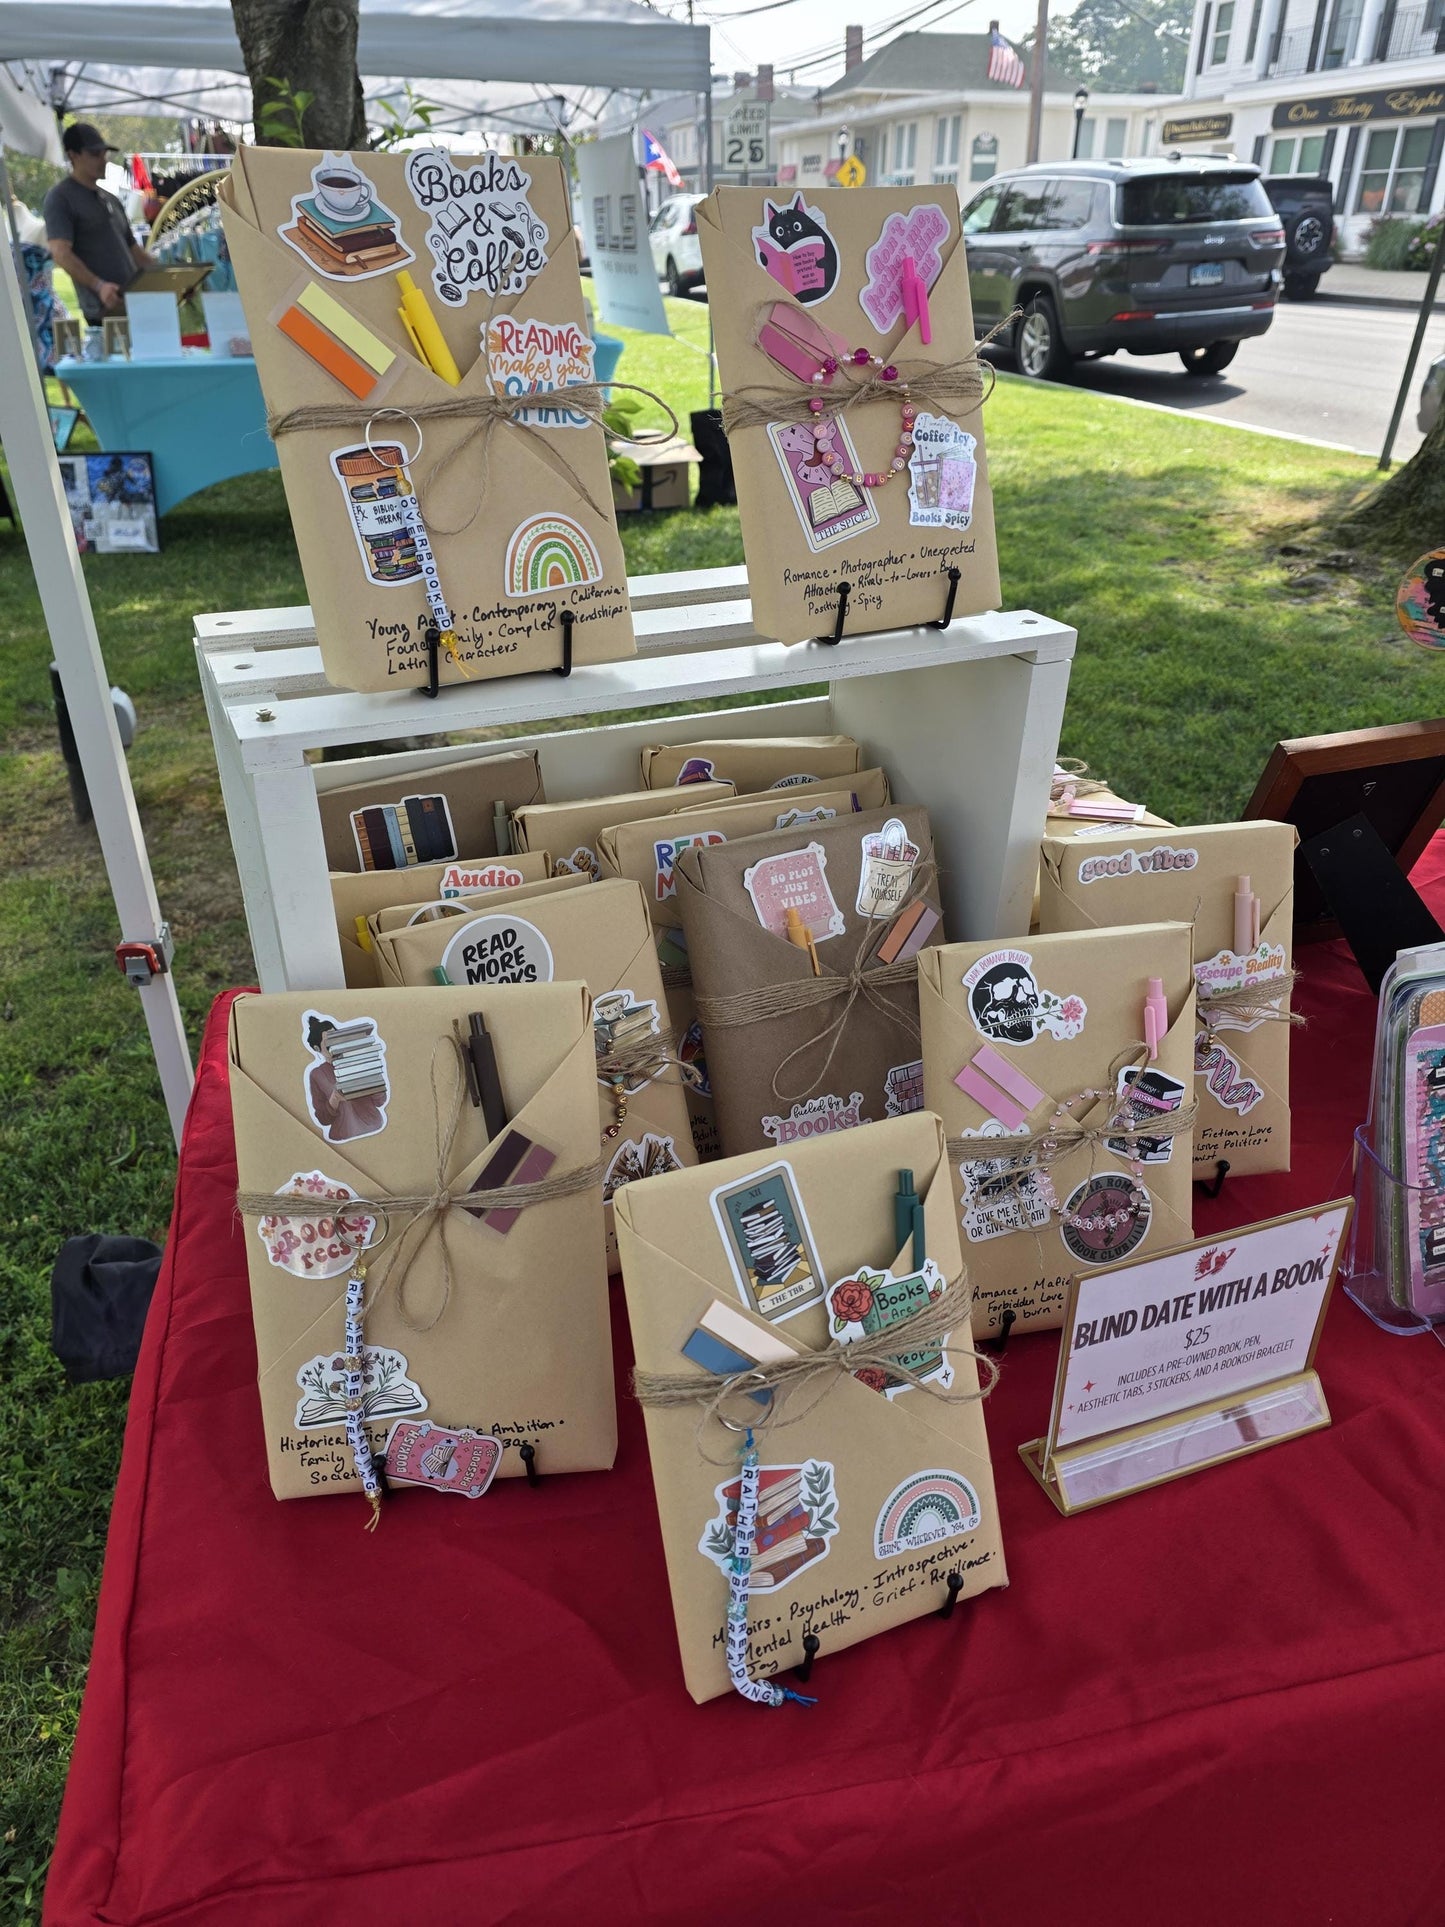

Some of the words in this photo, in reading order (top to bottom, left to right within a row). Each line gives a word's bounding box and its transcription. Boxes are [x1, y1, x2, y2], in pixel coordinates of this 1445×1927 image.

[1288, 103, 1319, 122] One
[1385, 90, 1444, 115] Eight
[729, 123, 761, 135] LIMIT
[727, 138, 764, 164] 25
[410, 153, 528, 206] Books
[473, 203, 494, 236] &
[1204, 234, 1226, 244] Jeep
[443, 240, 544, 293] Coffee
[496, 321, 582, 358] READING
[490, 346, 552, 380] makes
[557, 358, 590, 387] you
[914, 429, 950, 443] Coffee
[953, 431, 970, 446] Icy
[818, 525, 840, 540] THE
[840, 511, 869, 530] SPICE
[912, 511, 942, 523] Books
[945, 513, 970, 526] Spicy
[784, 569, 830, 586] Romance
[841, 550, 907, 579] Photographer
[920, 539, 976, 562] Unexpected
[366, 619, 410, 641] Young
[472, 600, 557, 623] Contemporary
[570, 587, 622, 605] California
[858, 592, 883, 612] Spicy
[498, 619, 555, 639] Complex
[444, 869, 521, 888] Audio
[770, 873, 786, 886] NO
[788, 866, 814, 880] PLOT
[1082, 853, 1132, 882] good
[1138, 850, 1196, 872] vibes
[780, 892, 818, 909] VIBES
[783, 881, 809, 894] JUST
[462, 928, 517, 966] READ
[466, 945, 526, 985] MORE
[979, 951, 1007, 972] ROMANCE
[1008, 951, 1030, 965] READER
[1195, 965, 1243, 980] Escape
[1245, 954, 1283, 975] Reality
[793, 1100, 825, 1118] fueled
[827, 1096, 841, 1111] by
[778, 1108, 857, 1142] Books
[1202, 1128, 1239, 1139] Fiction
[1248, 1126, 1273, 1137] Love
[1223, 1138, 1262, 1149] Politics
[996, 1207, 1010, 1219] ME
[970, 1227, 983, 1238] OR
[1006, 1216, 1019, 1227] ME
[301, 1241, 352, 1269] recs
[1070, 1240, 1098, 1260] BOOK
[1100, 1243, 1130, 1260] CLUB
[769, 1293, 788, 1306] THE
[788, 1284, 805, 1297] TBR
[876, 1284, 925, 1311] Books
[972, 1286, 1018, 1302] Romance
[987, 1297, 1035, 1313] Forbidden
[1040, 1292, 1064, 1302] Love
[1074, 1309, 1139, 1351] BLIND
[1140, 1292, 1196, 1331] DATE
[1198, 1278, 1253, 1315] WITH
[1251, 1271, 1268, 1299] A
[1270, 1254, 1330, 1293] BOOK
[891, 1306, 913, 1319] Are
[1023, 1307, 1051, 1318] burn
[1184, 1325, 1211, 1351] $25
[1117, 1364, 1158, 1387] INCLUDES
[1158, 1362, 1165, 1373] A
[1166, 1347, 1217, 1372] PRE-OWNED
[1243, 1334, 1261, 1348] PEN,
[1077, 1392, 1120, 1414] AESTHETIC
[1122, 1384, 1145, 1400] TABS,
[1146, 1382, 1154, 1393] 3
[1154, 1370, 1192, 1390] STICKERS,
[1193, 1364, 1212, 1379] AND
[1212, 1362, 1219, 1372] A
[1220, 1350, 1256, 1371] BOOKISH
[1256, 1338, 1295, 1360] BRACELET
[491, 1420, 556, 1437] Ambition
[300, 1451, 344, 1473] Family
[395, 1429, 421, 1473] BOOKISH
[460, 1444, 484, 1487] PASSPORT
[737, 1467, 759, 1556] RATHER
[906, 1526, 947, 1547] WHEREVER
[790, 1587, 859, 1625] Psychology
[873, 1543, 968, 1589] Introspective
[873, 1579, 916, 1606] Grief
[727, 1621, 772, 1702] READING
[746, 1660, 779, 1677] Joy
